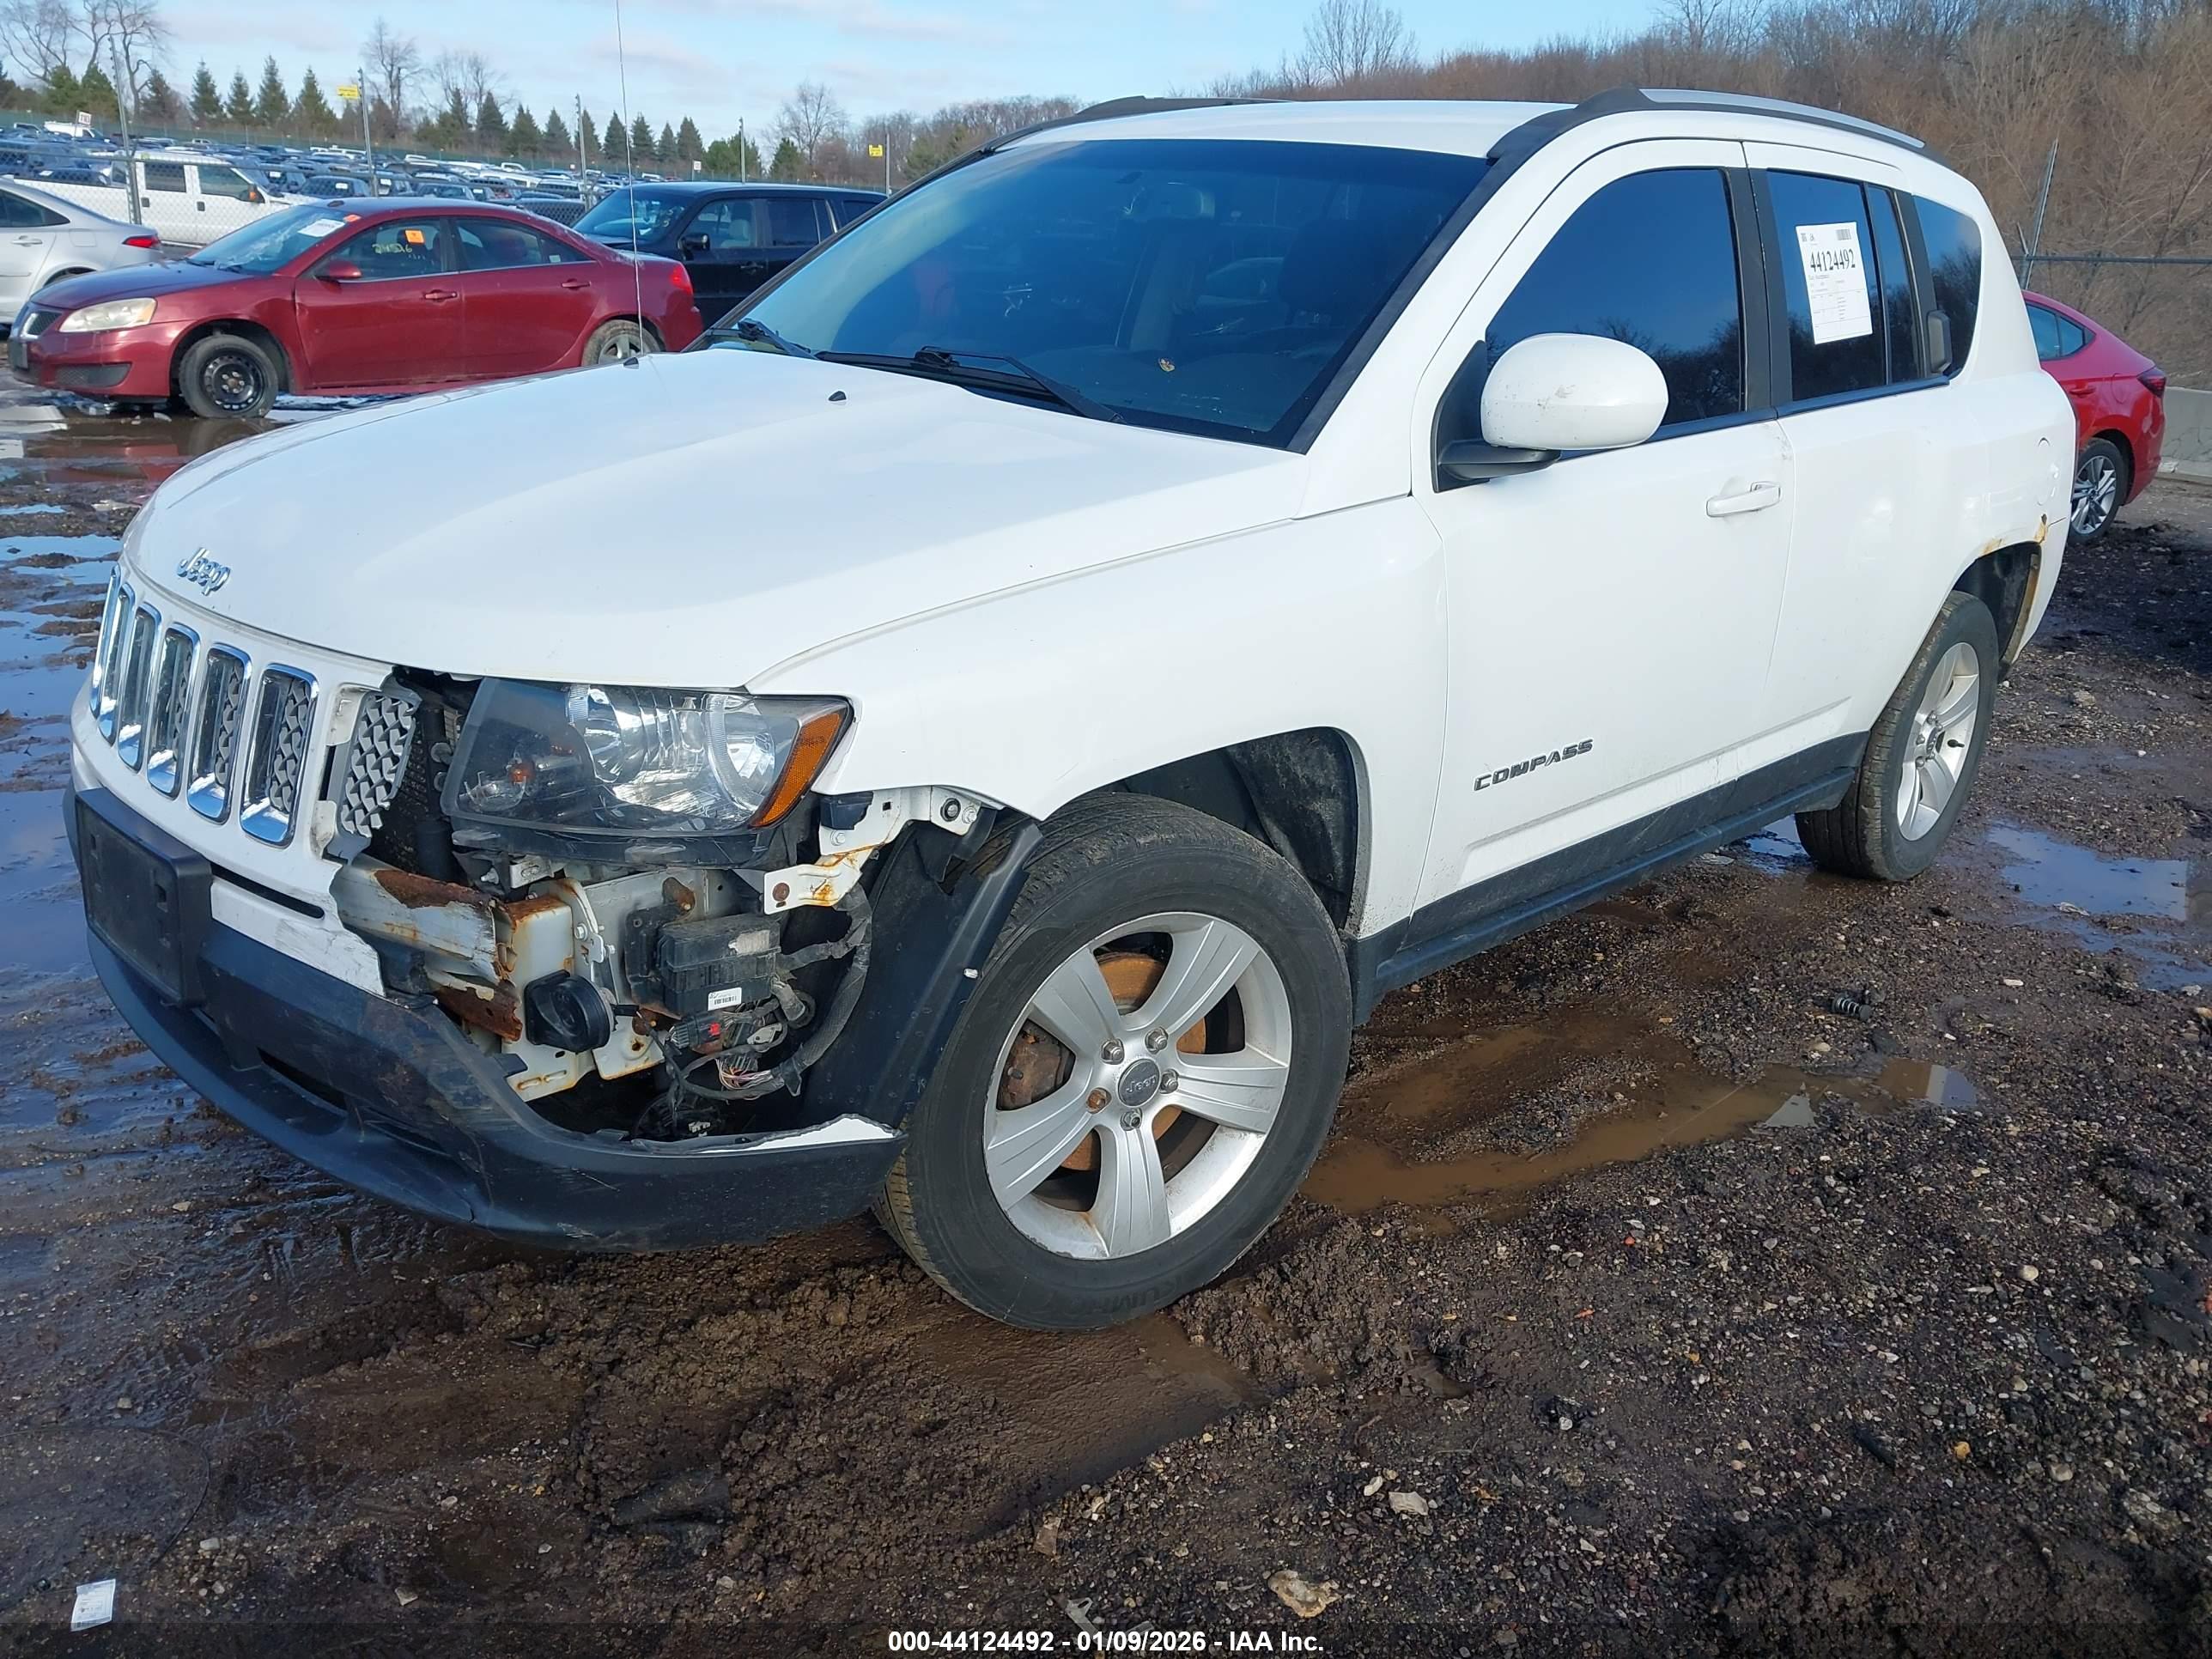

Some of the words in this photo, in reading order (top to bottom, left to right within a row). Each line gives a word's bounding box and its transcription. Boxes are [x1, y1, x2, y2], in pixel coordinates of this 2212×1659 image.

[1810, 249, 1856, 272] 44124492
[178, 547, 231, 596] Jeep
[1474, 738, 1594, 791] COMPASS
